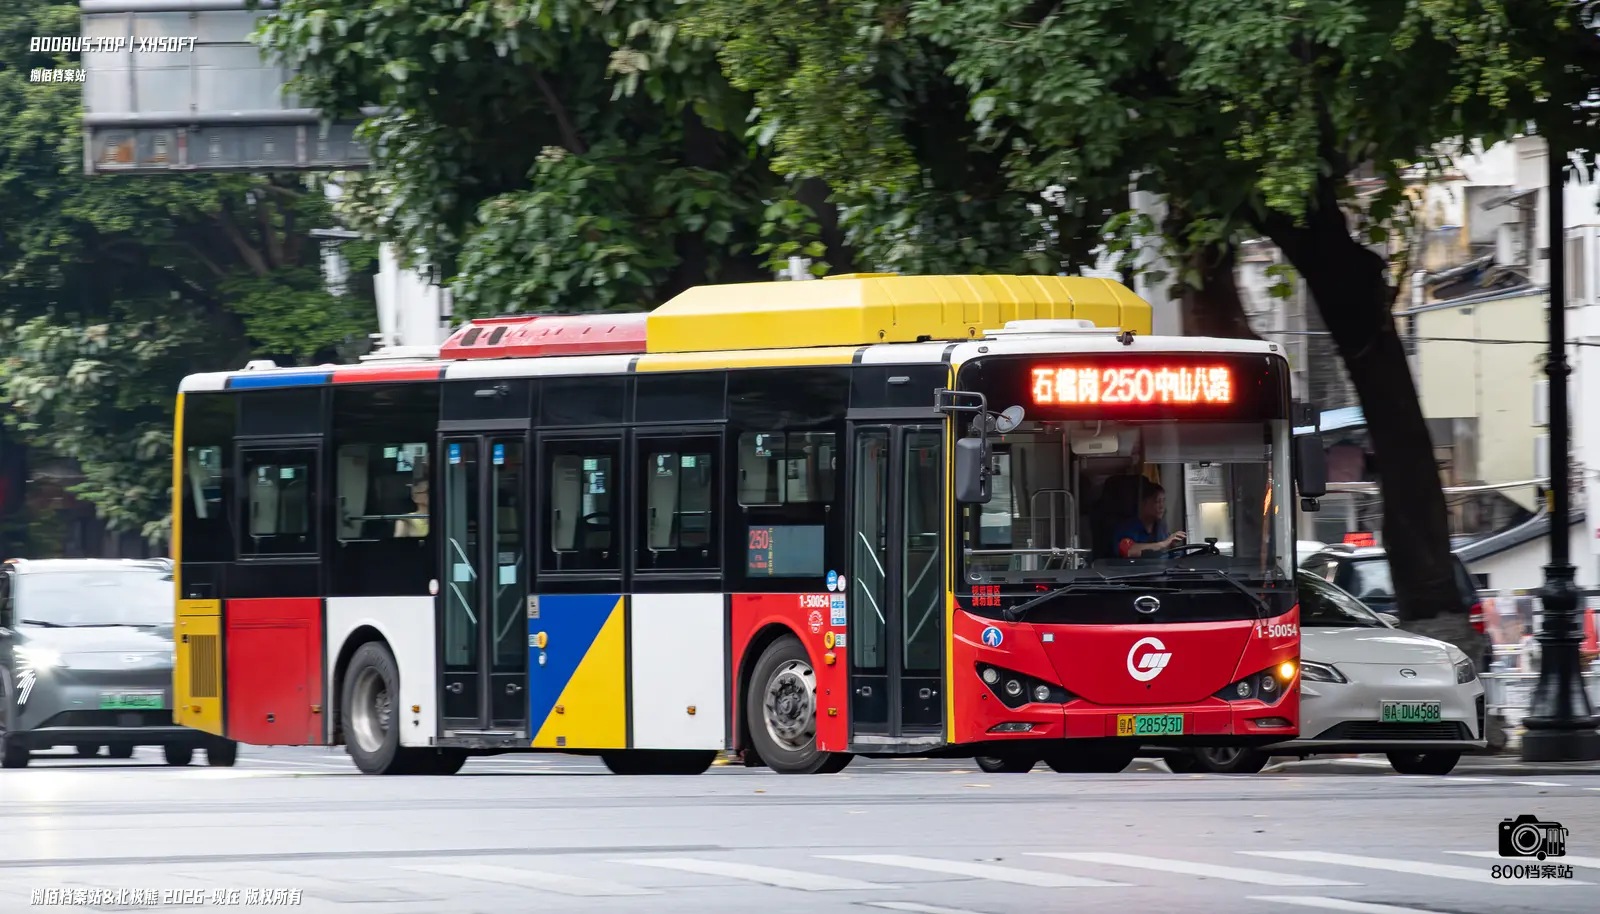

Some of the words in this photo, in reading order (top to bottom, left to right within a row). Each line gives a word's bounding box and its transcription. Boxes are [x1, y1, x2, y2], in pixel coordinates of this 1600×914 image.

[1101, 368, 1154, 402] 250
[1155, 366, 1231, 403] 中山八路
[749, 530, 769, 549] 250
[799, 595, 829, 608] 1-50054
[1256, 624, 1297, 639] 1-50054
[1402, 704, 1440, 719] DU4588
[1139, 717, 1182, 733] 28593D
